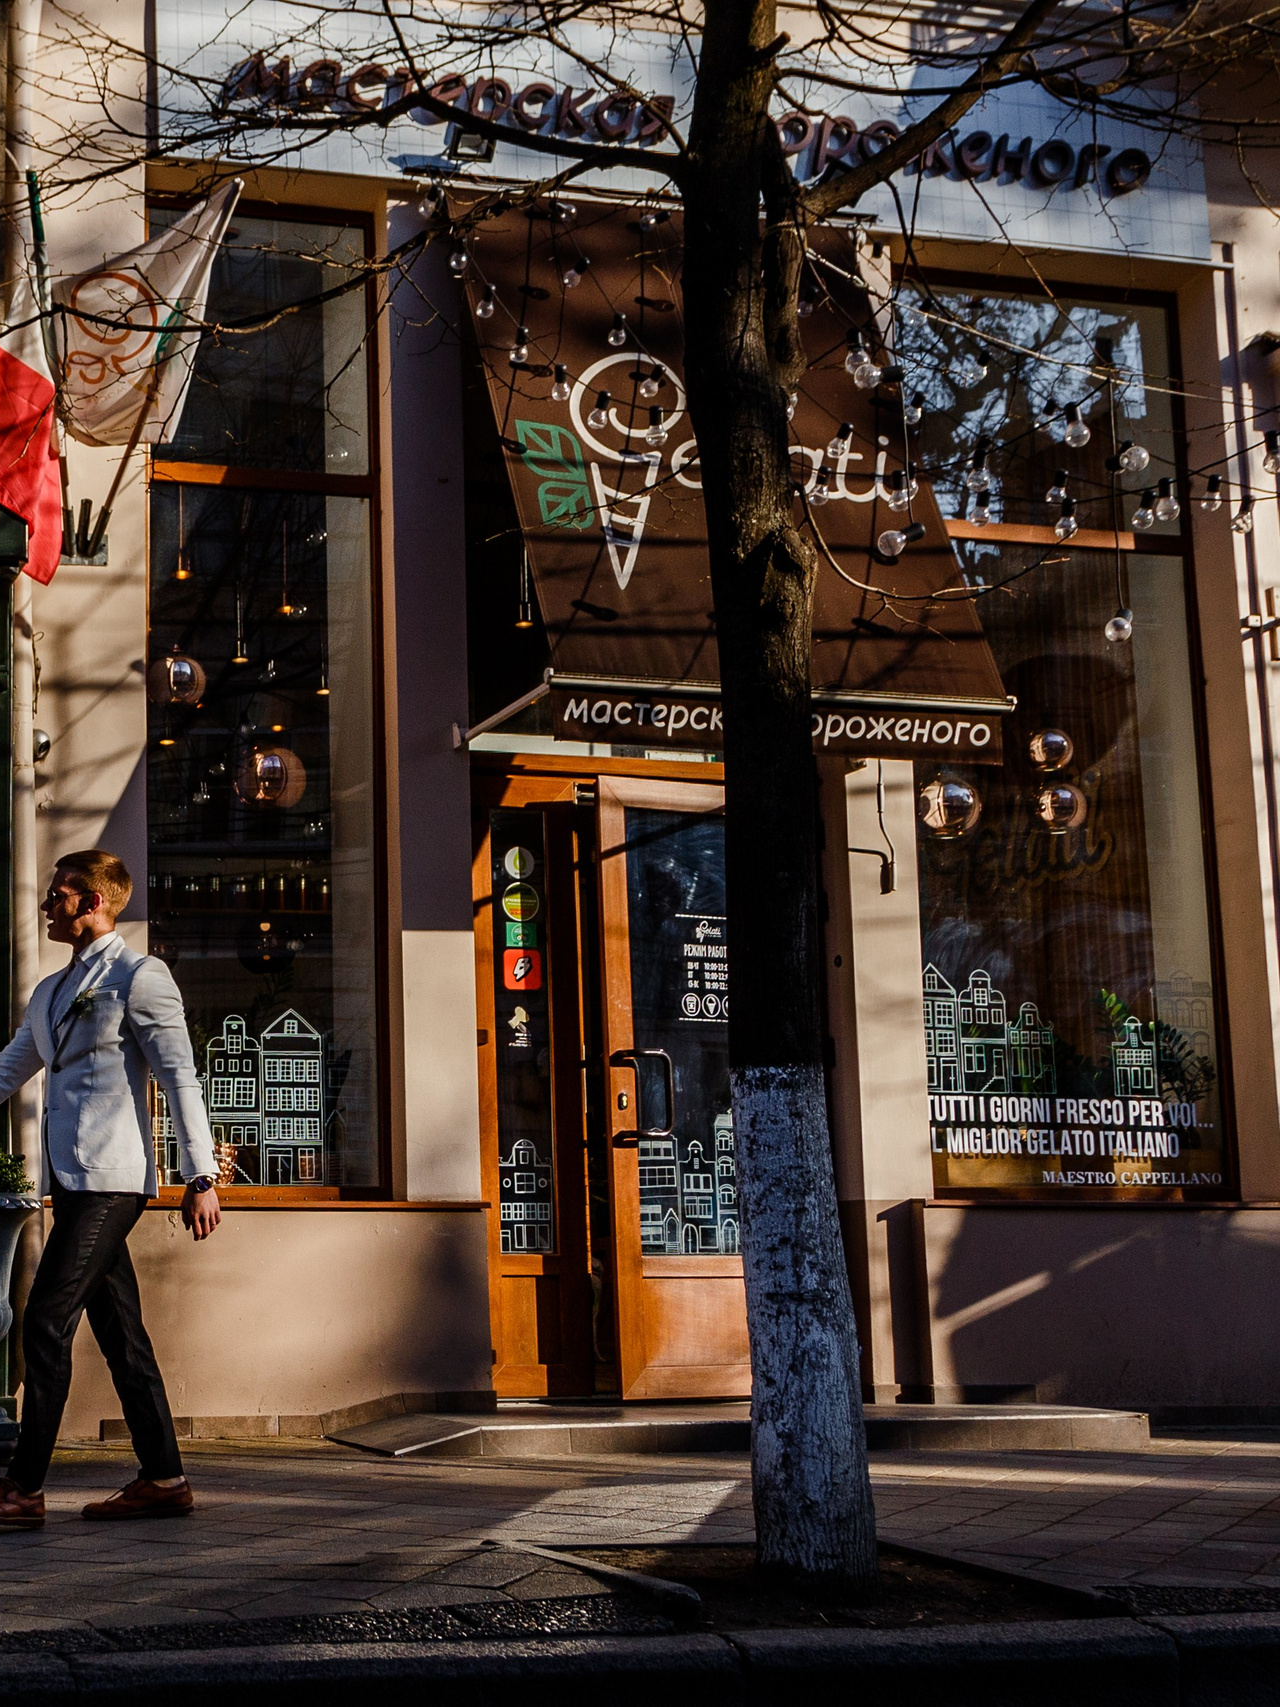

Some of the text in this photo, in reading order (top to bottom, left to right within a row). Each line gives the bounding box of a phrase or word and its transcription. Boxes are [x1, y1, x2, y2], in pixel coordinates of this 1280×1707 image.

[775, 111, 1151, 195] ороженого
[569, 352, 906, 504] Geati
[563, 698, 991, 746] мастерск ороженого
[684, 943, 727, 959] РЕЖИМ РАБОТ
[927, 1095, 975, 1121] TUTTI
[979, 1096, 986, 1121] I
[990, 1096, 1051, 1123] GIORNI
[1056, 1098, 1124, 1125] FRESCO
[1128, 1101, 1165, 1127] PER
[946, 1127, 1023, 1154] MIGLIOR
[1026, 1129, 1095, 1156] GELATO
[1099, 1131, 1180, 1158] ITALIANO
[1042, 1170, 1222, 1186] MAESTRO CAPPELLANO
